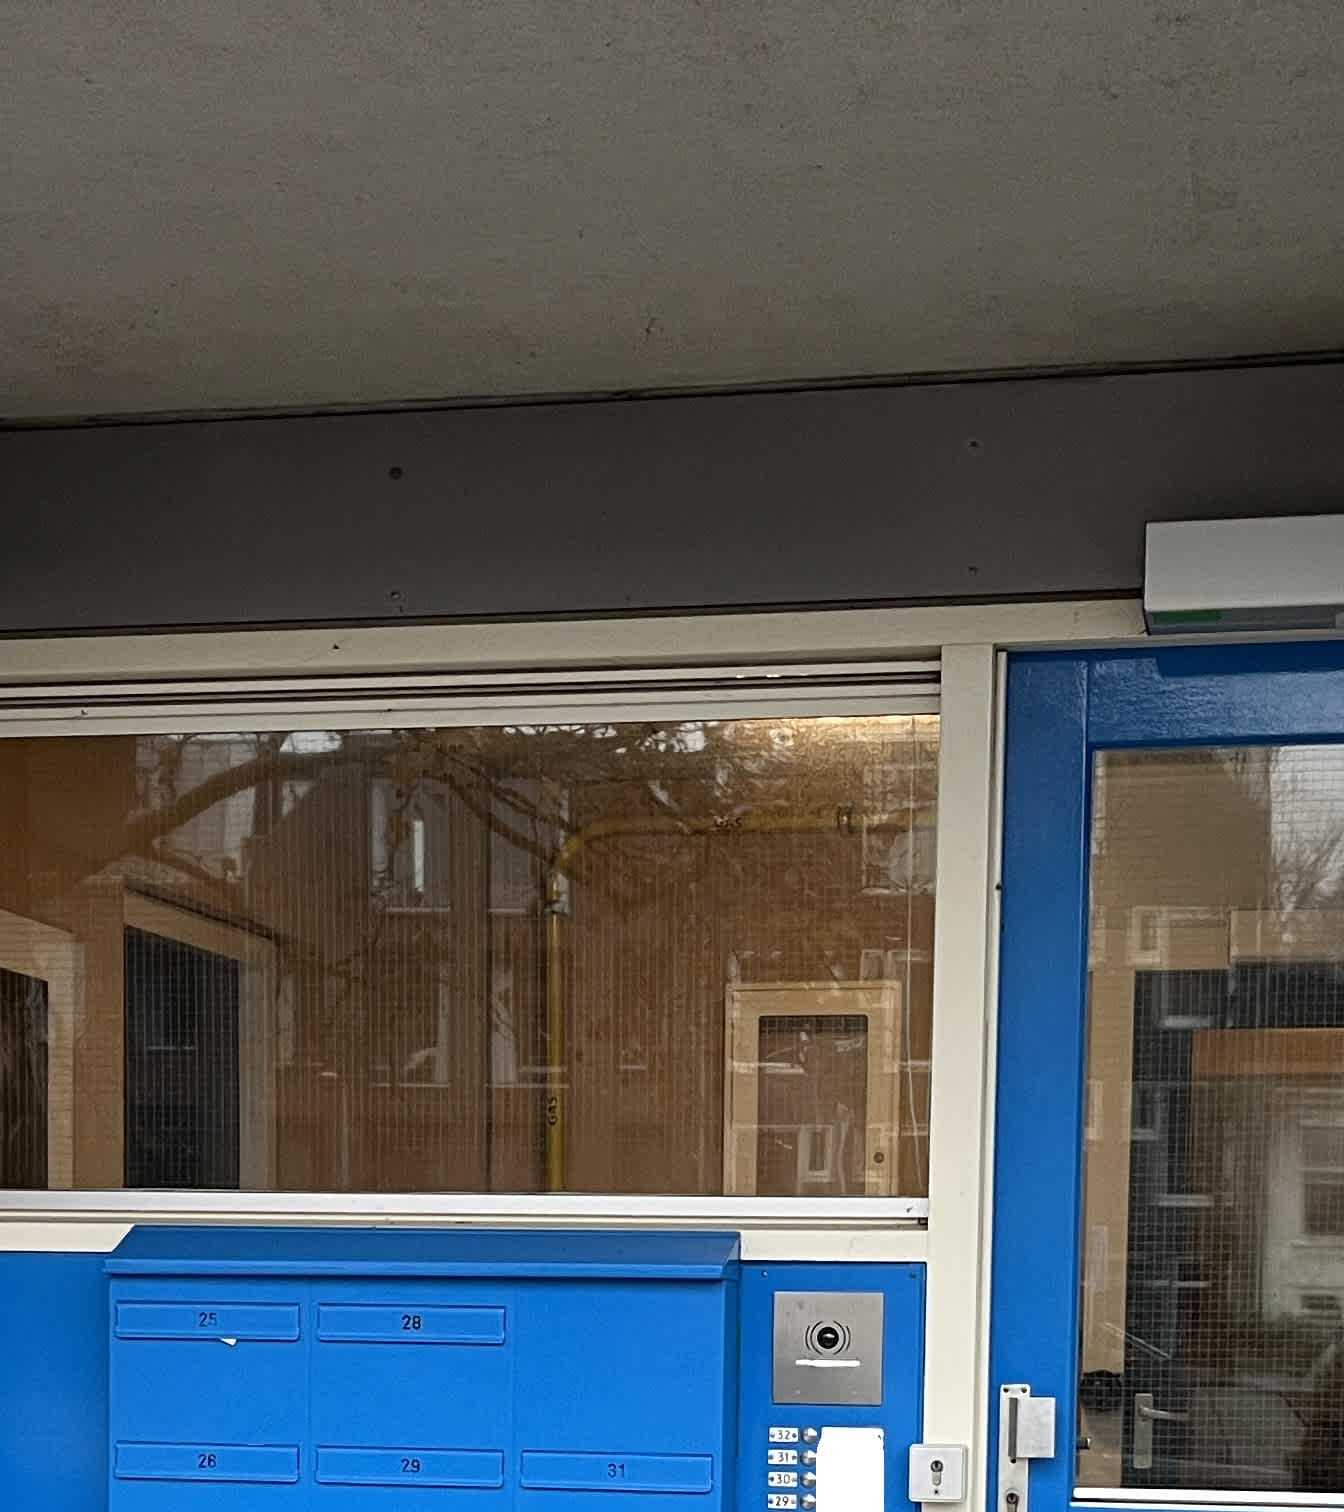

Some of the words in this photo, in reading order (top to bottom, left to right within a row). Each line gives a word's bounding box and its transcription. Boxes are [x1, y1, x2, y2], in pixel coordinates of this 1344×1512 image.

[199, 1311, 217, 1327] 25
[401, 1314, 421, 1330] 28
[778, 1429, 790, 1440] 32
[198, 1453, 216, 1468] 26
[778, 1451, 788, 1462] 31
[401, 1458, 420, 1473] 29
[608, 1463, 625, 1478] 31
[777, 1473, 791, 1484] 30
[776, 1495, 789, 1506] 29
